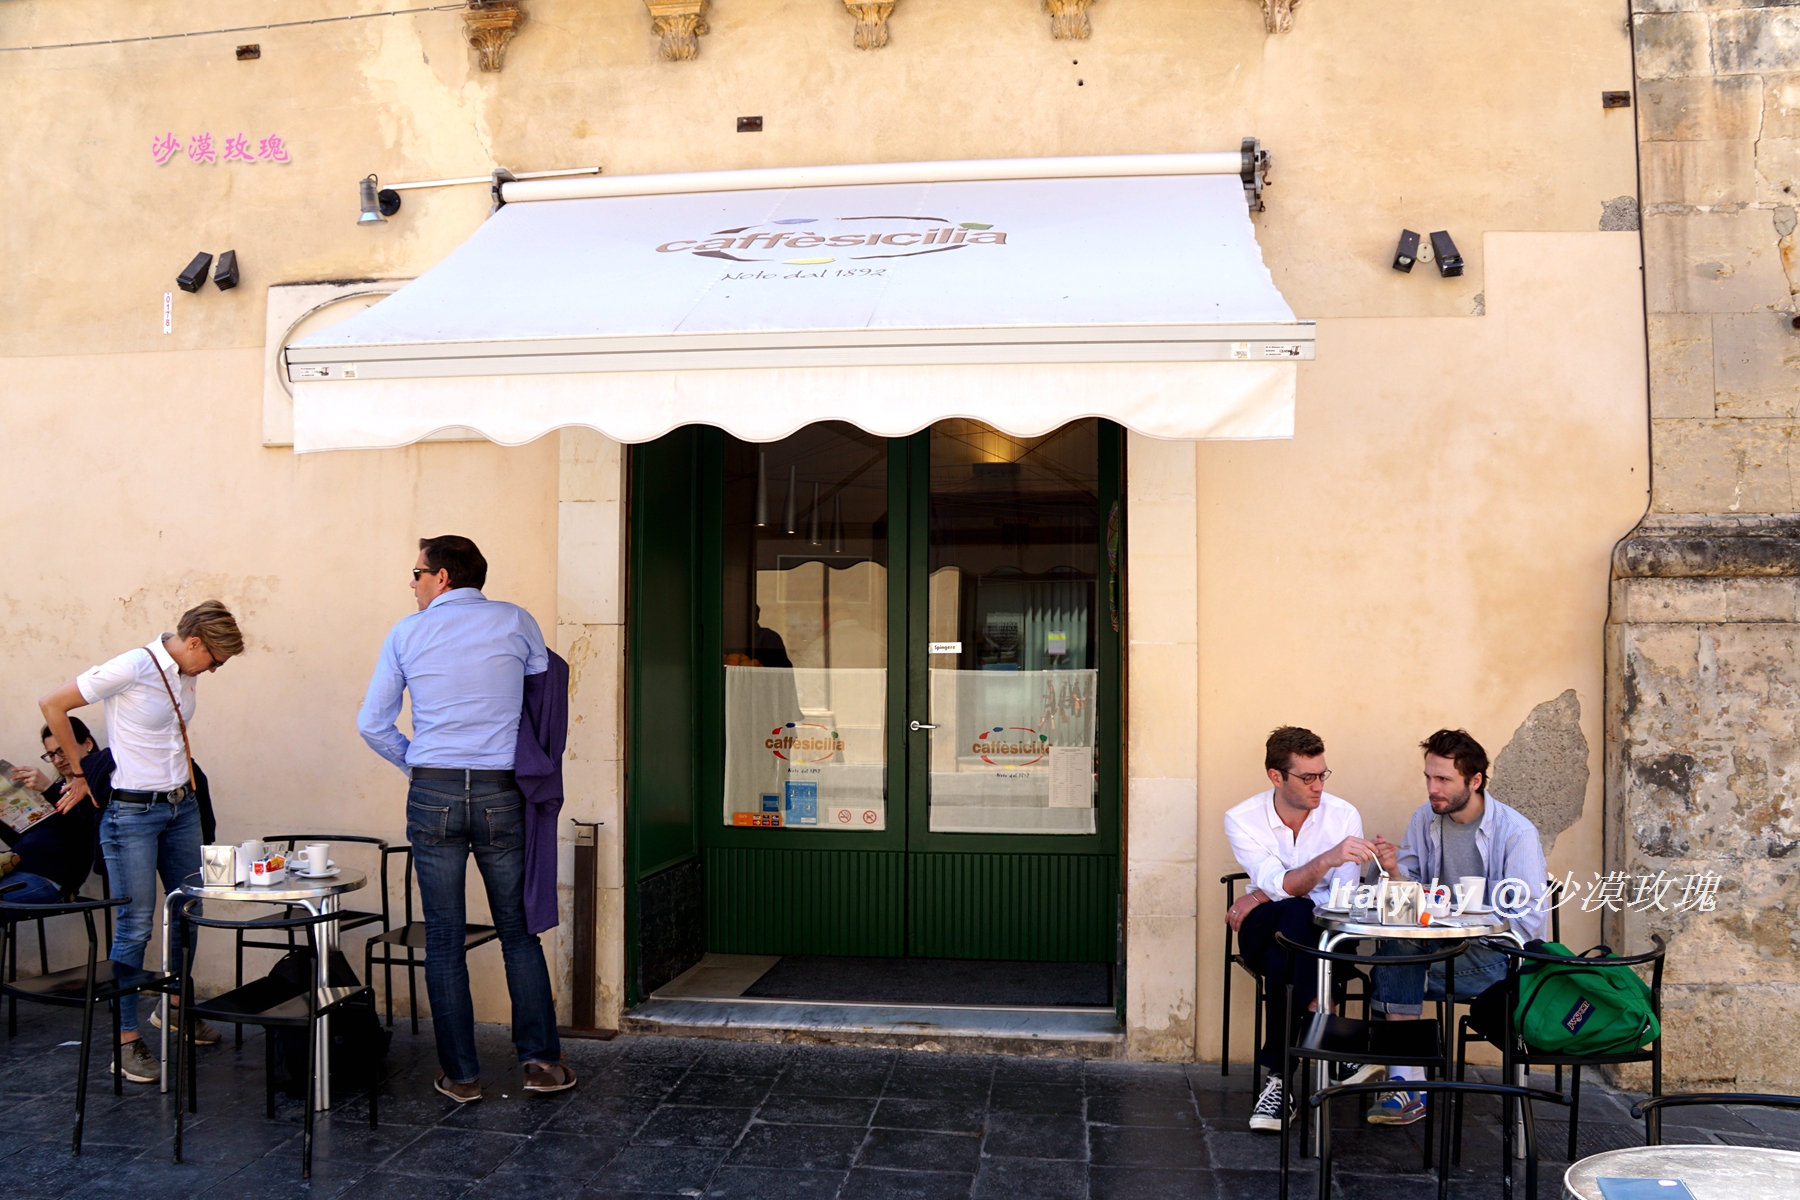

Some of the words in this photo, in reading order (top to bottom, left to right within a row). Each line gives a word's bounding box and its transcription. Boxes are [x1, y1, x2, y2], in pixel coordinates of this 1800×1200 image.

[655, 228, 1008, 253] caffèsicilia
[783, 269, 828, 280] dal
[835, 268, 887, 278] 1892
[764, 736, 846, 751] caffèsicilia
